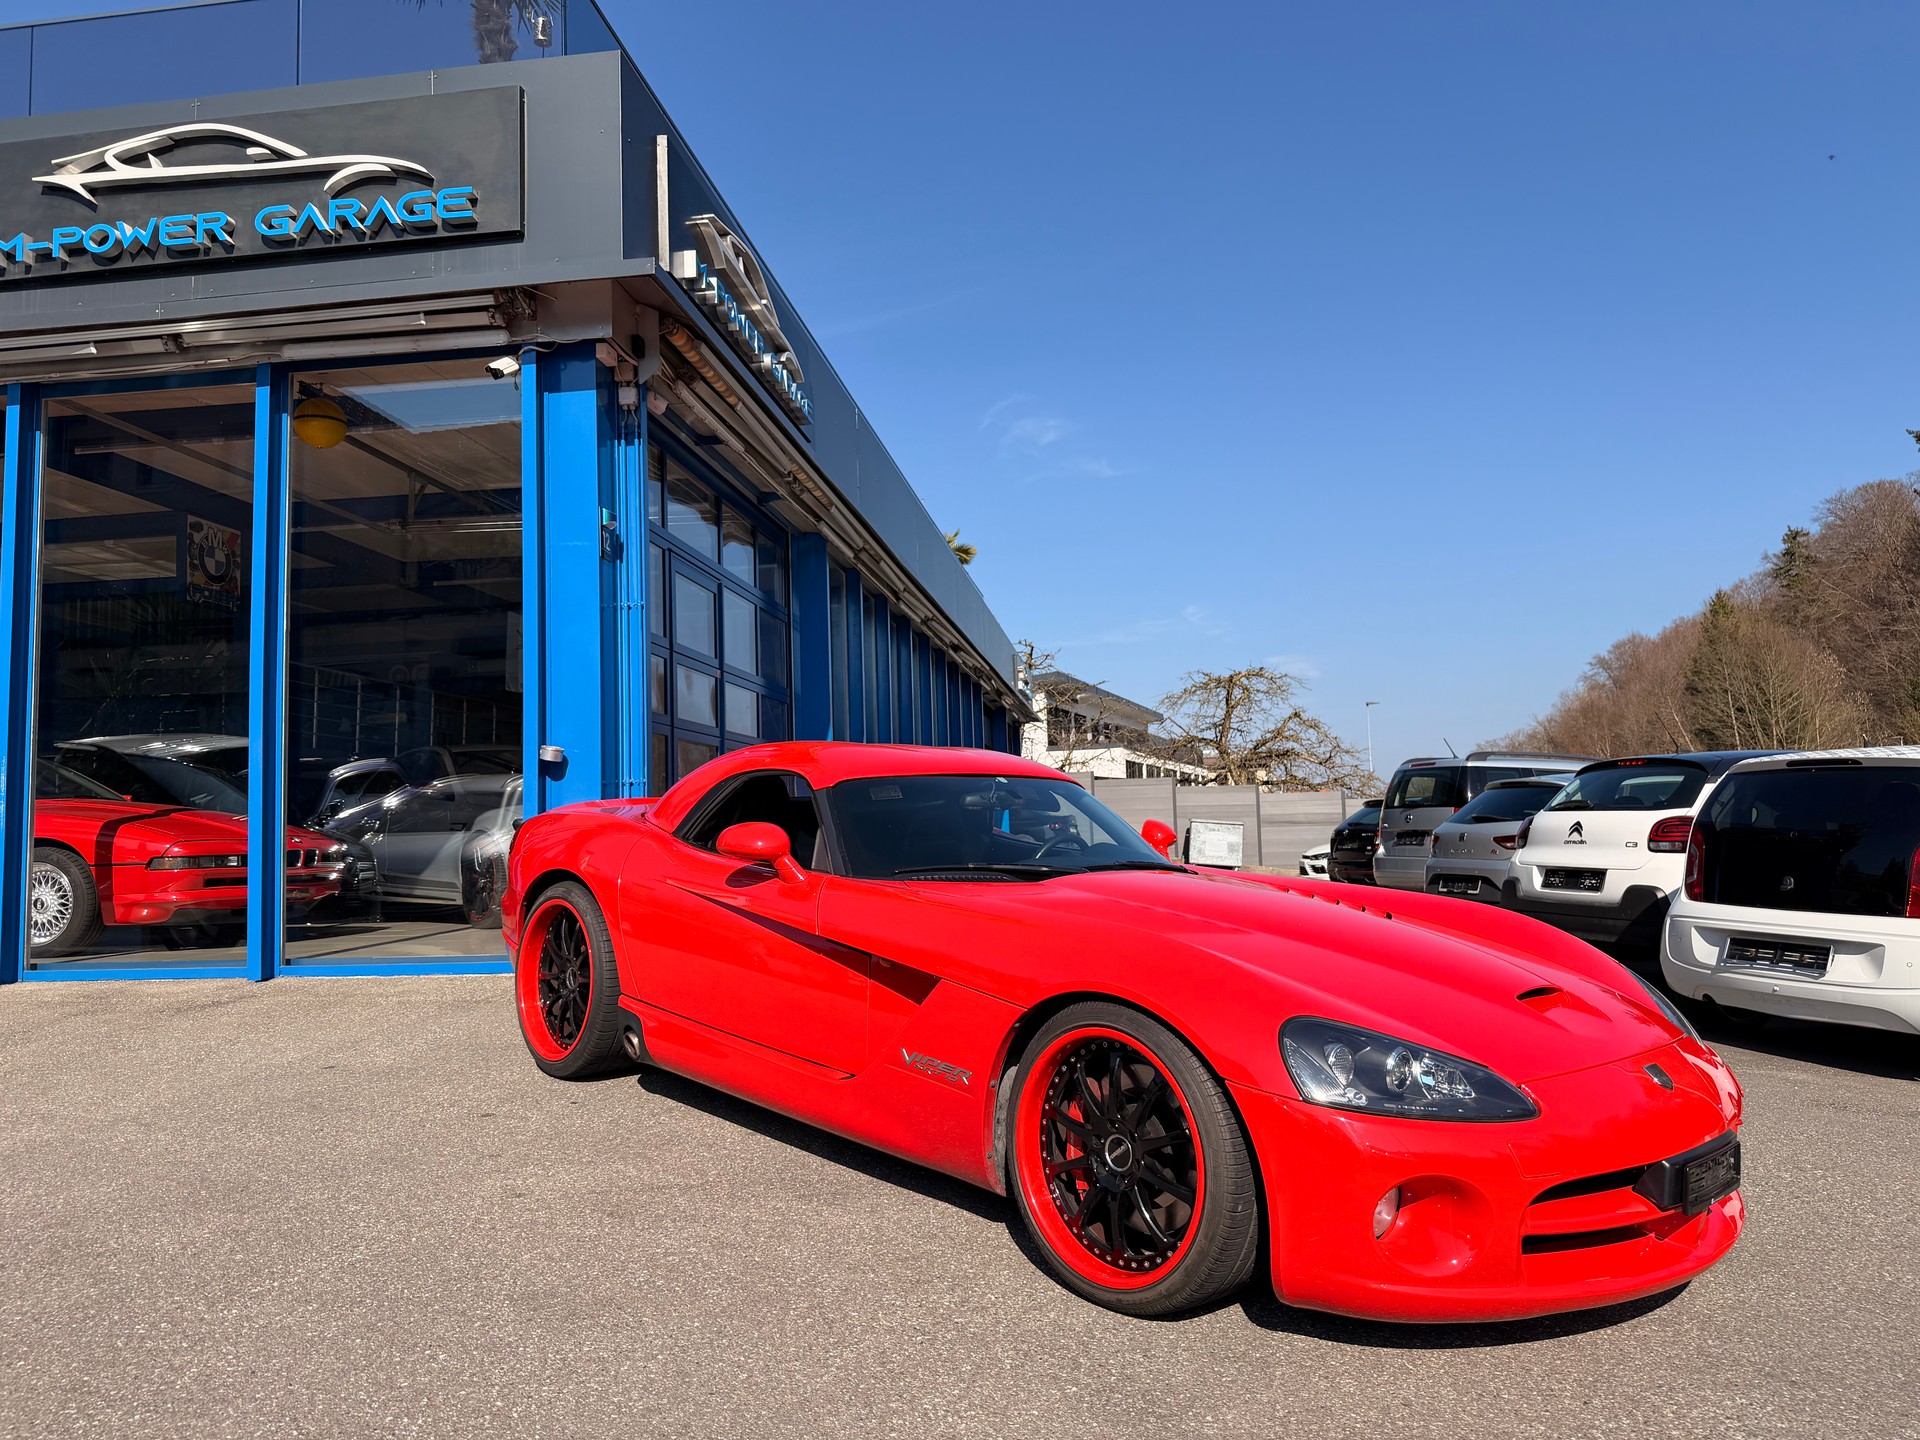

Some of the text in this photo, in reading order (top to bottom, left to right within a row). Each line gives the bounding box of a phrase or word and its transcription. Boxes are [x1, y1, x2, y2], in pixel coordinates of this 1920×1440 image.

[254, 186, 474, 236] GARAGE
[602, 530, 611, 551] 12
[901, 1047, 972, 1085] VIPER
